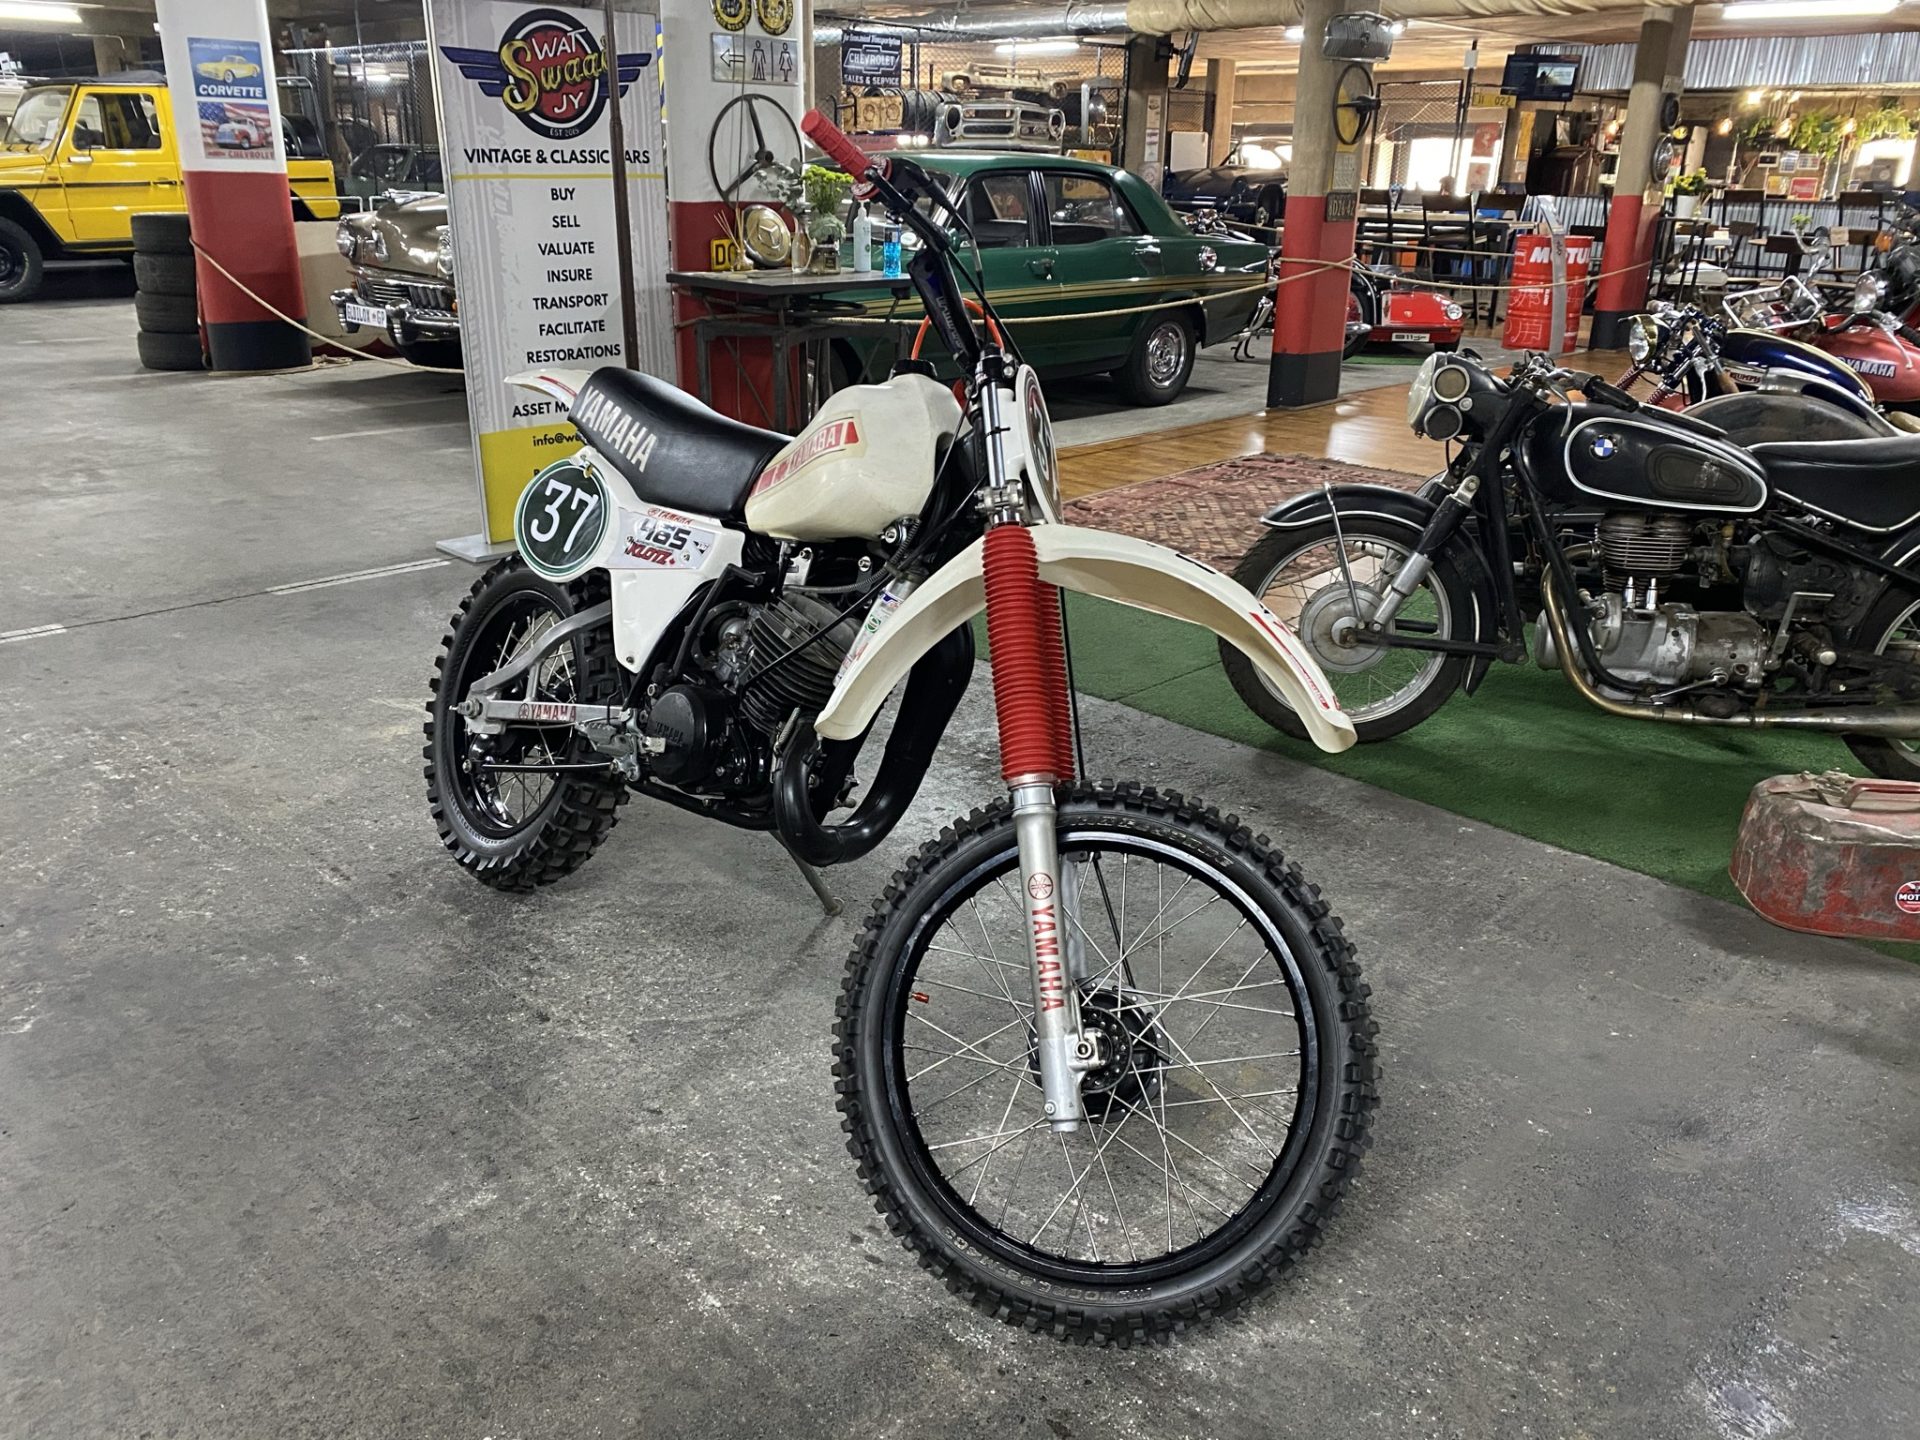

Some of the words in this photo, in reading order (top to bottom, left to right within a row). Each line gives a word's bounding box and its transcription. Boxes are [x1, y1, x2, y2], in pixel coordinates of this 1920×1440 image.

[849, 53, 895, 66] CHEVROLET
[843, 74, 863, 84] SALES
[872, 76, 899, 85] SERVICE
[199, 84, 263, 97] CORVETTE
[554, 91, 584, 114] JY
[464, 149, 531, 163] VINTAGE
[536, 150, 547, 163] &
[550, 150, 610, 163] CLASSIC
[625, 150, 650, 164] ARS
[550, 188, 575, 200] BUY
[552, 215, 581, 228] SELL
[538, 241, 595, 255] VALUATE
[547, 268, 593, 282] INSURE
[532, 293, 608, 310] TRANSPORT
[539, 320, 605, 336] FACILITATE
[527, 344, 621, 363] RESTORATIONS
[1847, 359, 1896, 378] YAMAHA
[512, 402, 551, 418] ASSET
[577, 385, 657, 473] YAMAHA
[530, 478, 599, 553] 37
[530, 704, 577, 721] YAMAHA
[1032, 904, 1065, 1013] YAMAHA
